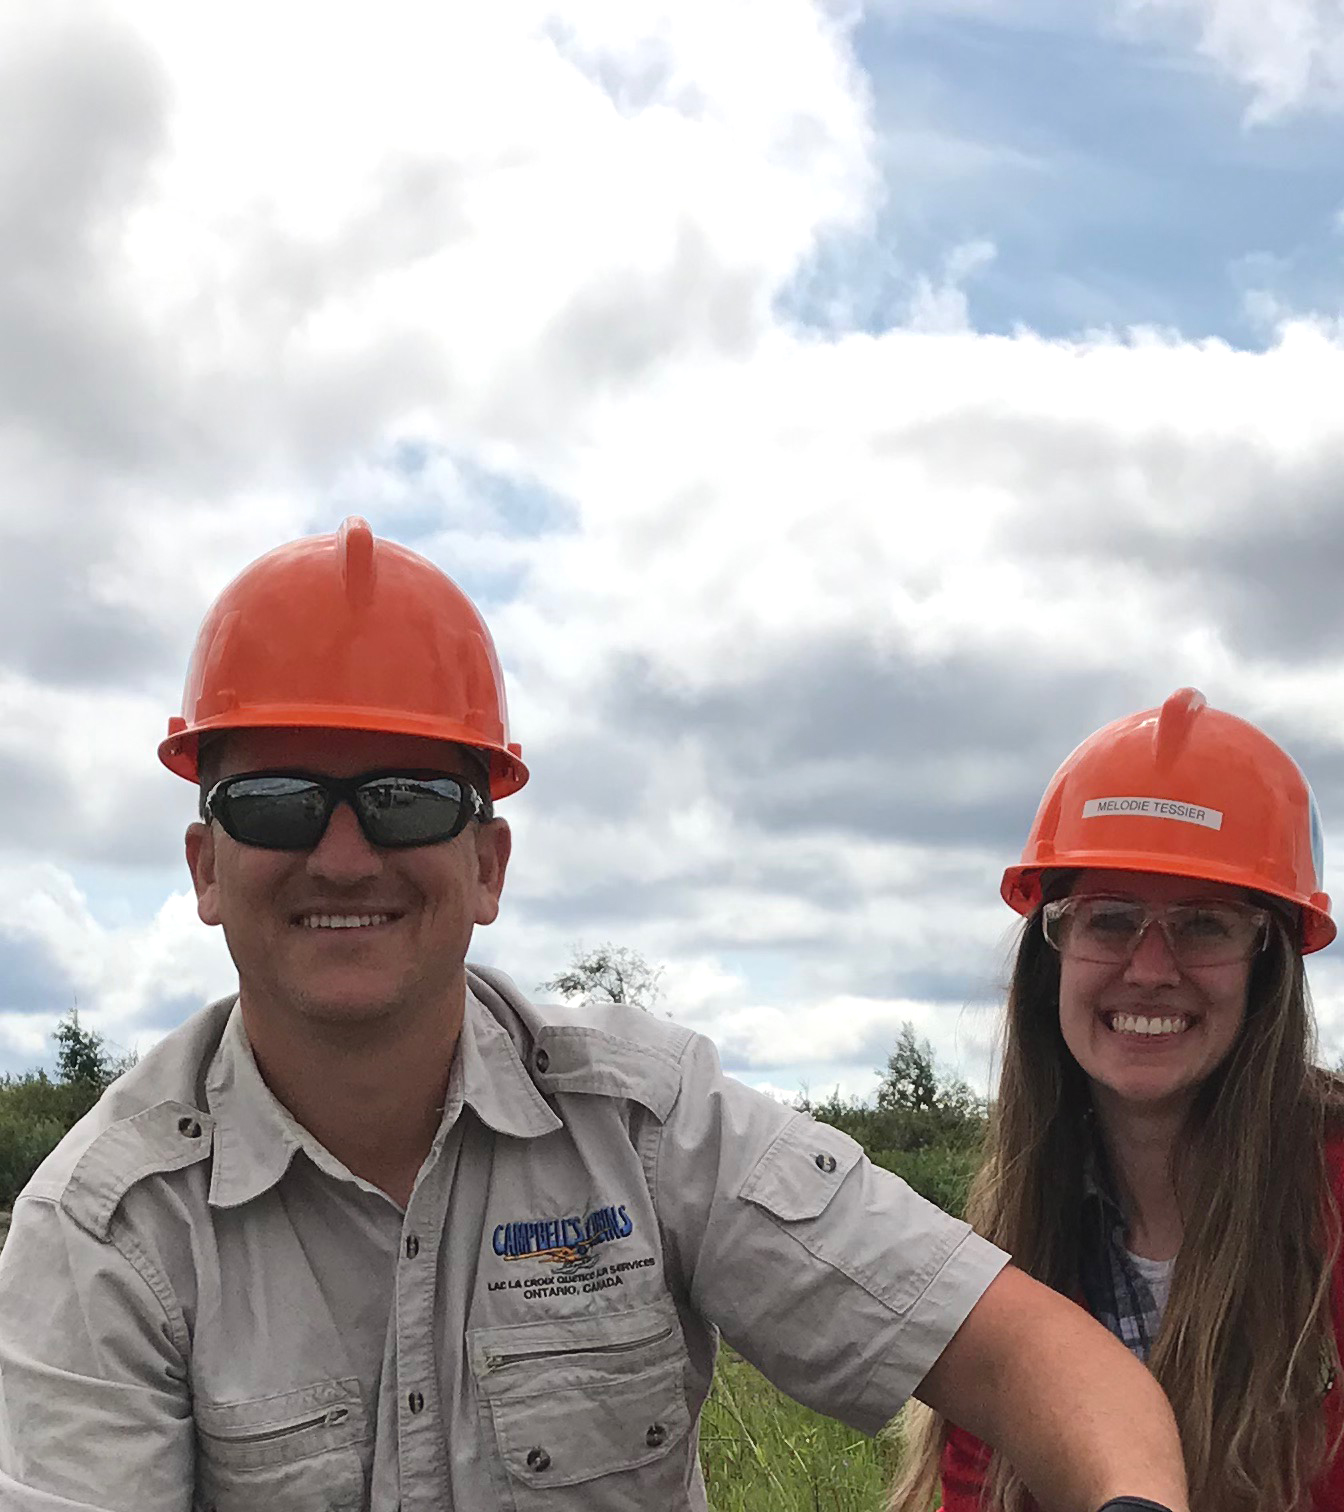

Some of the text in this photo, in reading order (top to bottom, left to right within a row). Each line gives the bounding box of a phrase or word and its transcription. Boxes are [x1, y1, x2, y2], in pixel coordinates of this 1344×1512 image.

[1097, 800, 1206, 821] MELODIE TESSIER
[487, 1281, 507, 1292] LAC
[508, 1279, 523, 1290] LA
[524, 1276, 555, 1289] CROIX
[582, 1275, 624, 1294] CANADA
